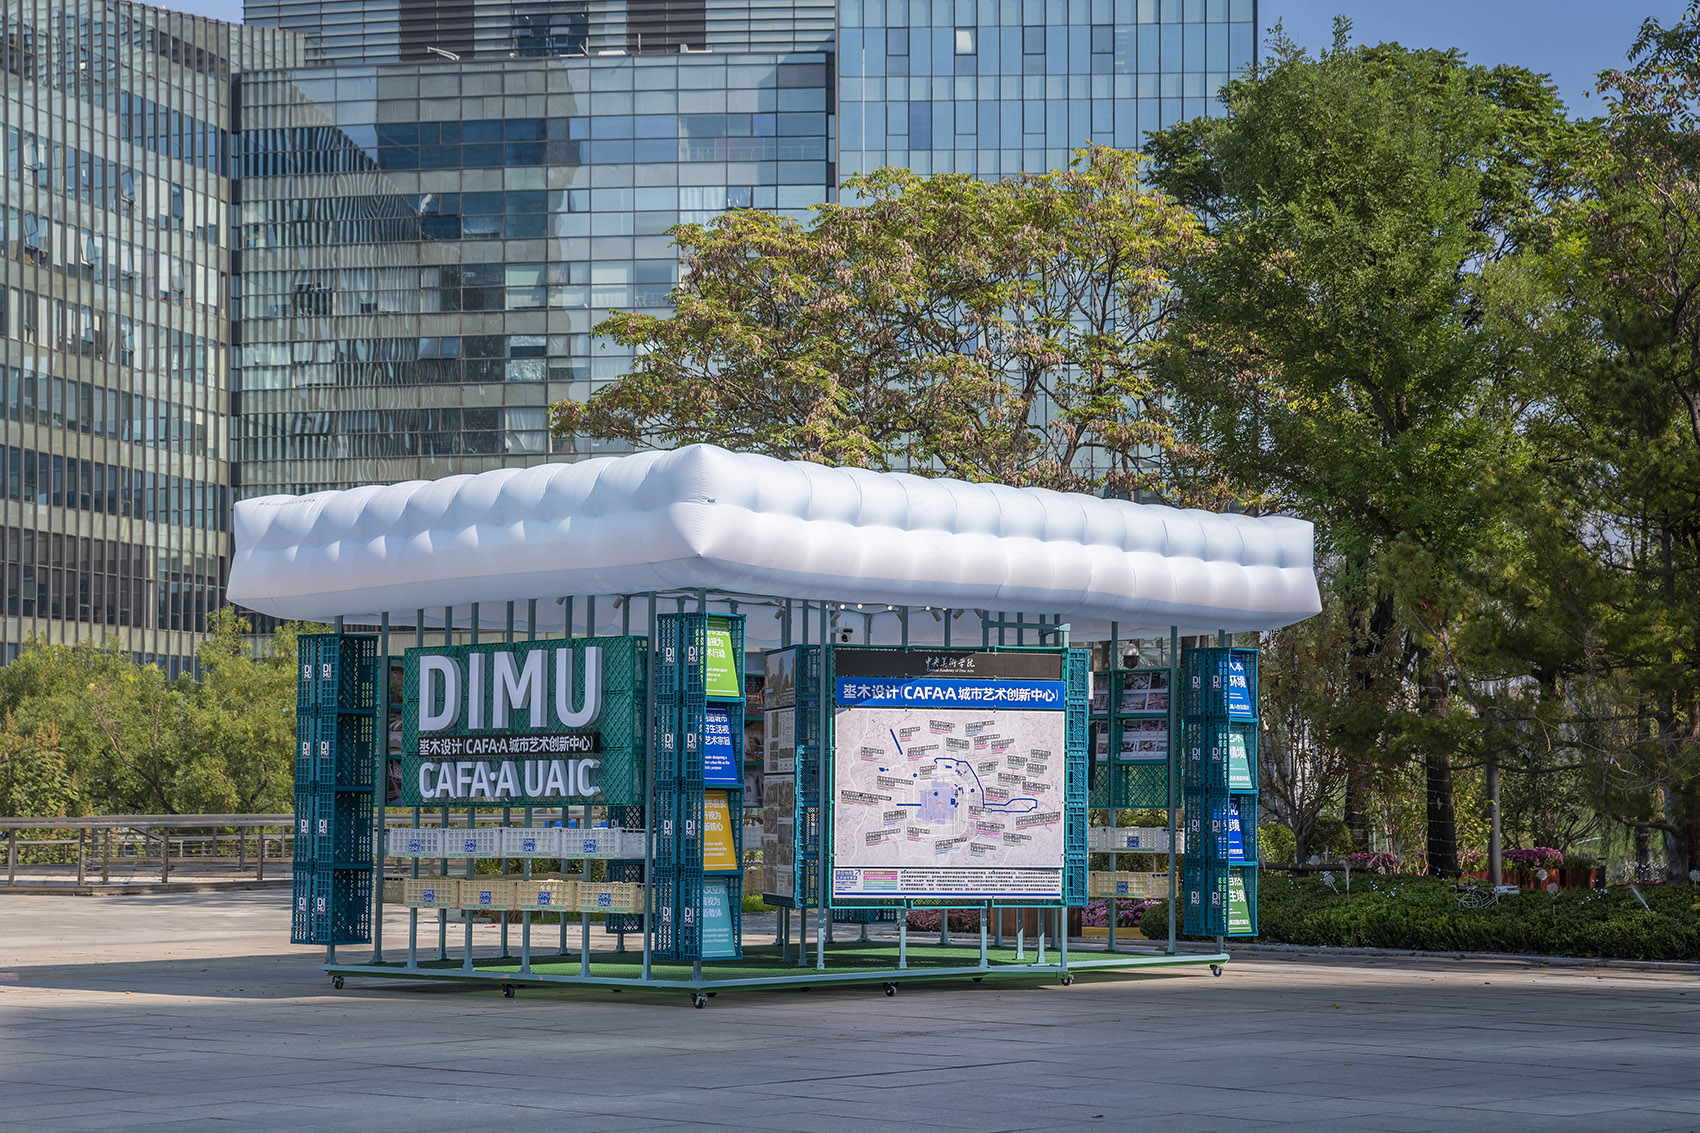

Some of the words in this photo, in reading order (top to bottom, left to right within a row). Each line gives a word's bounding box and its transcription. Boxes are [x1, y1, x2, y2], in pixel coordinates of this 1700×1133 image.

[666, 647, 674, 656] DI
[688, 646, 697, 656] DI
[305, 665, 312, 673] DI
[323, 664, 331, 672] DI
[1193, 676, 1201, 684] DI
[1213, 675, 1221, 684] DI
[418, 646, 602, 731] DIMU
[665, 733, 673, 742] DI
[687, 733, 696, 742] DI
[303, 742, 310, 750] DI
[321, 742, 329, 750] DI
[1193, 747, 1200, 755] DI
[1213, 747, 1221, 755] DI
[524, 758, 601, 797] UAIC
[301, 820, 308, 828] DI
[319, 819, 327, 828] DI
[664, 820, 672, 830] DI
[686, 820, 695, 830] DI
[1212, 820, 1220, 828] DI
[299, 898, 306, 906] DI
[317, 898, 325, 906] DI
[663, 907, 671, 916] DI
[685, 907, 694, 917] DI
